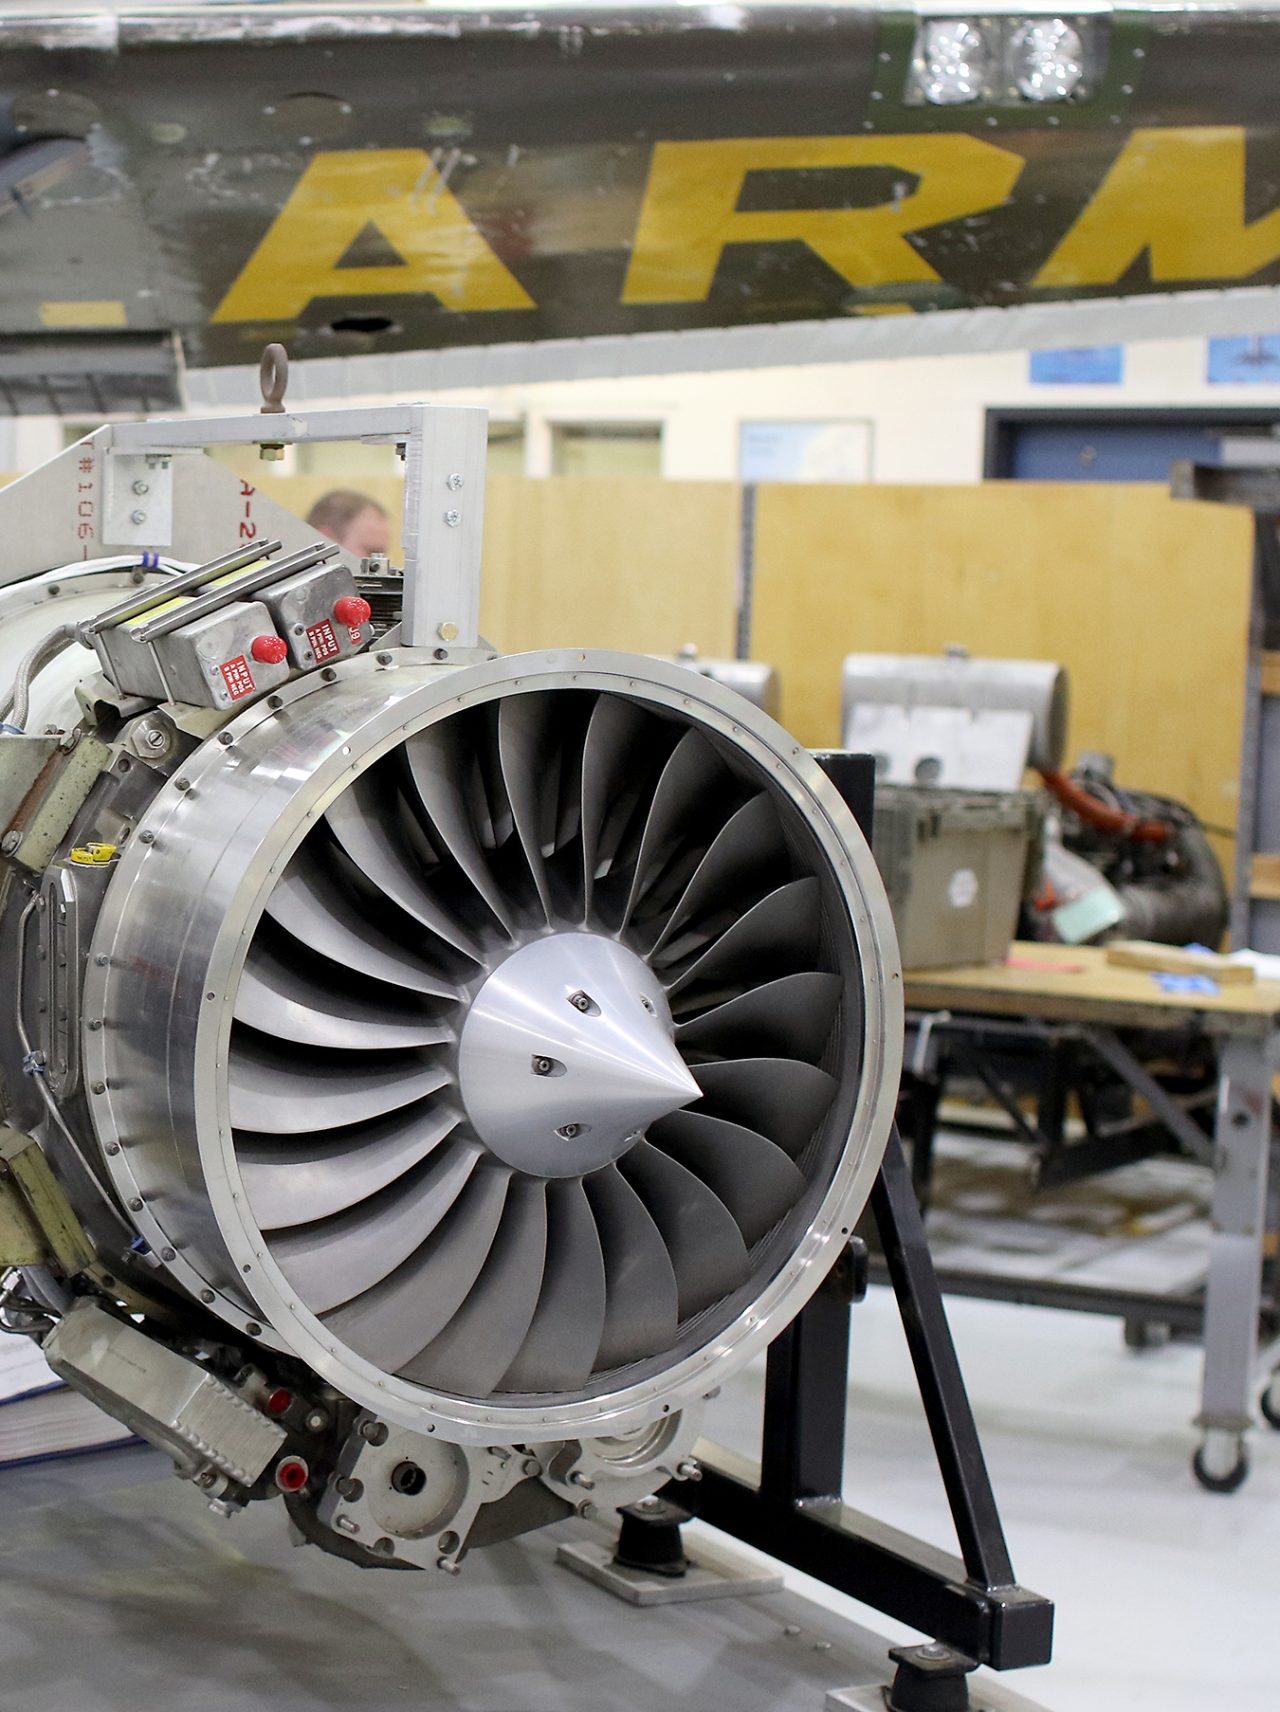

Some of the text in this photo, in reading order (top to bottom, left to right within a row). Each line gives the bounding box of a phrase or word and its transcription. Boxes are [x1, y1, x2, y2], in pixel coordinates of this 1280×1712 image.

[240, 479, 256, 547] A-2
[321, 624, 337, 652] INPUT
[236, 660, 253, 690] INPUT
